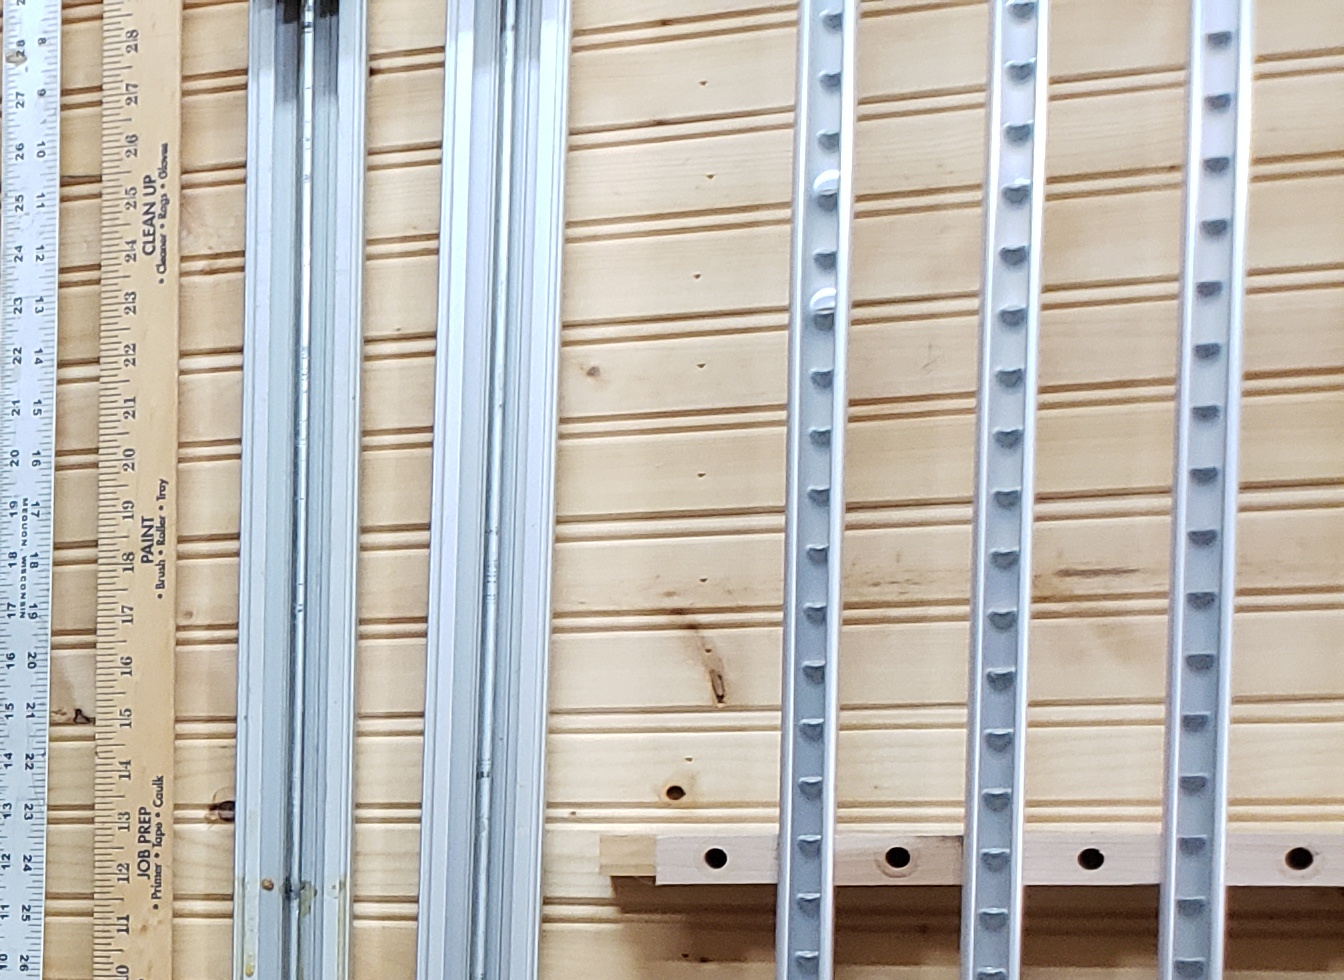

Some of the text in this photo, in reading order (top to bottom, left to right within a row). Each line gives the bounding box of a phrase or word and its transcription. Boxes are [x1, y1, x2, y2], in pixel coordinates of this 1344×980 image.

[126, 29, 139, 53] 28
[16, 92, 25, 108] 27
[125, 83, 138, 105] 27
[15, 142, 24, 160] 26
[37, 141, 46, 158] 10
[125, 134, 138, 158] 26
[15, 194, 24, 212] 25
[36, 193, 45, 208] 11
[125, 187, 138, 210] 25
[158, 193, 170, 219] Rags
[142, 175, 157, 256] CLEAN UP
[14, 245, 23, 262] 24
[35, 245, 44, 262] 12
[125, 240, 137, 262] 24
[157, 234, 167, 274] Cleaner
[13, 297, 22, 314] 23
[35, 296, 44, 314] 13
[124, 291, 137, 315] 23
[13, 347, 22, 364] 22
[34, 348, 43, 365] 14
[123, 343, 136, 367] 22
[11, 400, 20, 416] 21
[33, 399, 42, 416] 15
[123, 396, 136, 419] 21
[10, 450, 19, 467] 20
[31, 451, 41, 467] 16
[122, 448, 135, 472] 20
[9, 501, 18, 517] 19
[31, 501, 40, 518] 17
[122, 500, 134, 521] 19
[141, 516, 154, 563] PAINT
[155, 479, 169, 589] Brush Roller Tray
[8, 551, 17, 568] 18
[29, 552, 39, 569] 18
[122, 552, 134, 573] 18
[20, 555, 28, 619] WISCONSIN
[7, 602, 16, 619] 17
[28, 603, 38, 619] 19
[121, 605, 134, 626] 17
[6, 652, 15, 669] 16
[27, 652, 37, 669] 20
[120, 656, 132, 676] 16
[5, 703, 14, 720] 15
[26, 702, 36, 719] 21
[120, 708, 132, 728] 15
[4, 752, 13, 769] 14
[25, 753, 34, 770] 22
[119, 760, 131, 780] 14
[3, 803, 12, 819] 13
[24, 803, 34, 821] 23
[118, 811, 130, 832] 13
[137, 806, 151, 880] JOB PREP
[150, 775, 165, 900] Primer Tape Caulk
[1, 853, 11, 870] 12
[23, 854, 32, 872] 24
[117, 862, 130, 884] 12
[0, 904, 9, 920] 11
[22, 905, 31, 922] 25
[117, 915, 129, 935] 11
[19, 954, 29, 972] 26
